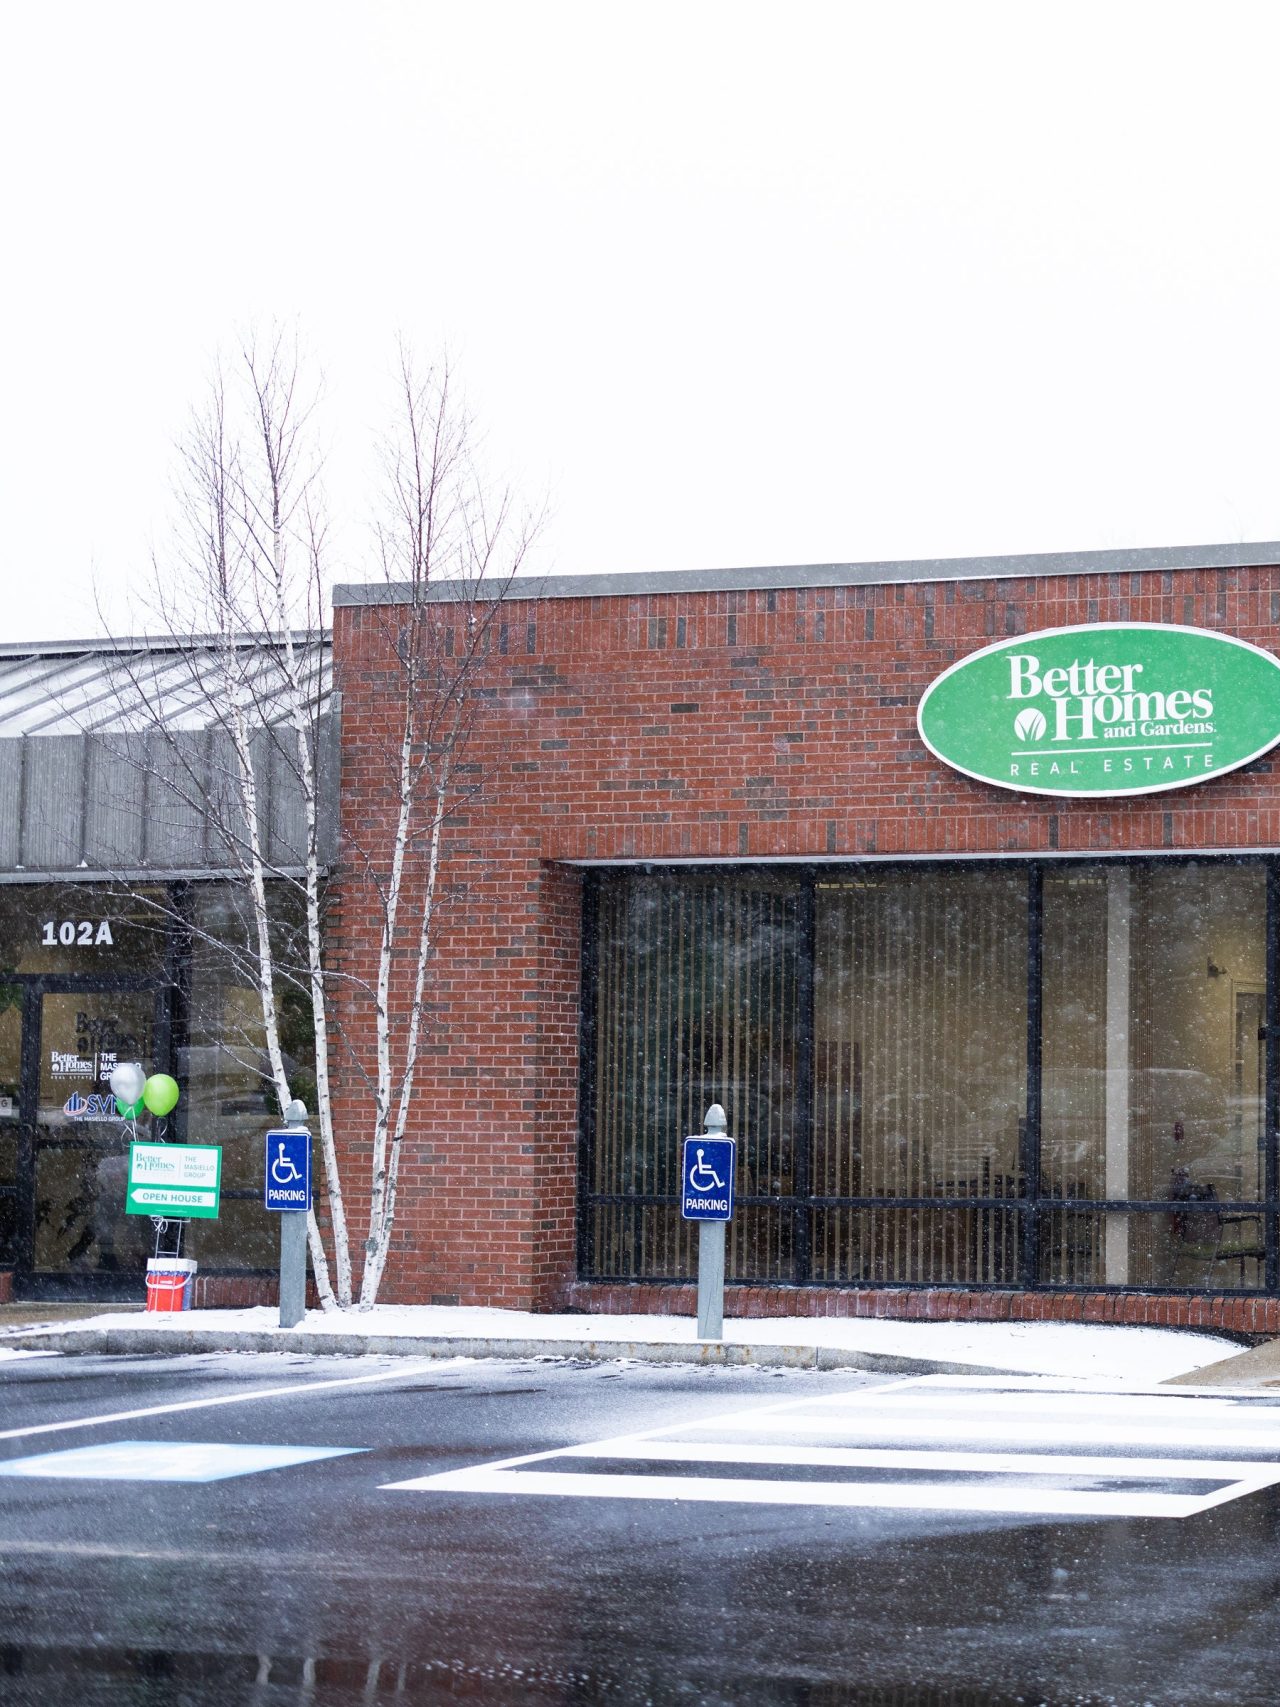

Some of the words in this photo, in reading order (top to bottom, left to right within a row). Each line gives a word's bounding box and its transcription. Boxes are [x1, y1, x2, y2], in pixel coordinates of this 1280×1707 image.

[1005, 654, 1144, 699] Better
[1051, 688, 1214, 741] Homes
[1103, 723, 1136, 739] and
[1140, 720, 1214, 737] Gardens
[1010, 761, 1079, 776] REAL
[1103, 754, 1214, 772] ESTATE
[42, 921, 114, 945] 102A
[51, 1051, 79, 1062] Better
[100, 1053, 117, 1061] THE
[59, 1061, 93, 1072] Homes
[142, 1192, 168, 1201] OPEN
[170, 1194, 204, 1203] HOUSE
[268, 1189, 306, 1201] PARKING
[686, 1198, 728, 1211] PARKING
